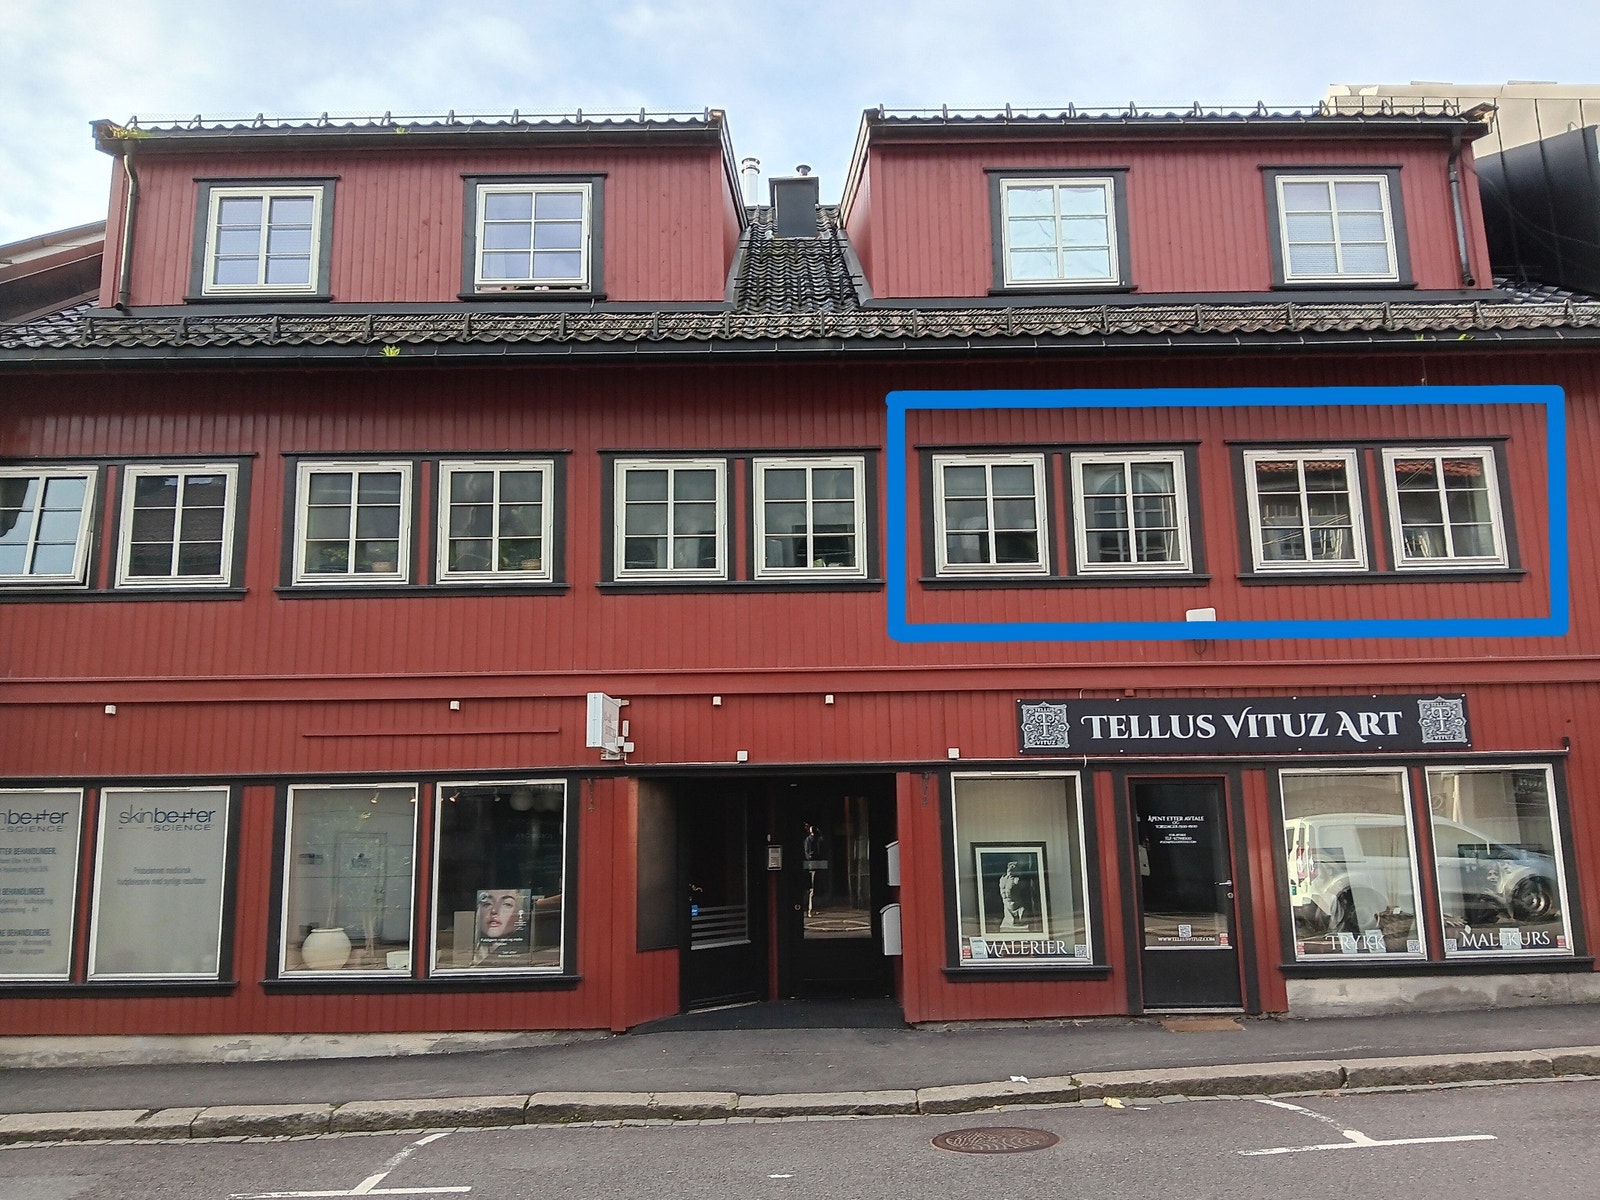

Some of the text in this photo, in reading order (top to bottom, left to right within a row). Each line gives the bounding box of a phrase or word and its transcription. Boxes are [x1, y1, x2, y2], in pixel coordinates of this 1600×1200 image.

[1081, 706, 1403, 743] TELLUS VITUZ ART
[119, 804, 216, 824] skinbetter
[7, 825, 63, 833] SCIENCE
[153, 824, 212, 832] SCIENCE
[983, 940, 1068, 957] MALERIER
[1325, 935, 1386, 950] TRYKK
[1460, 931, 1551, 949] MALEKURS
